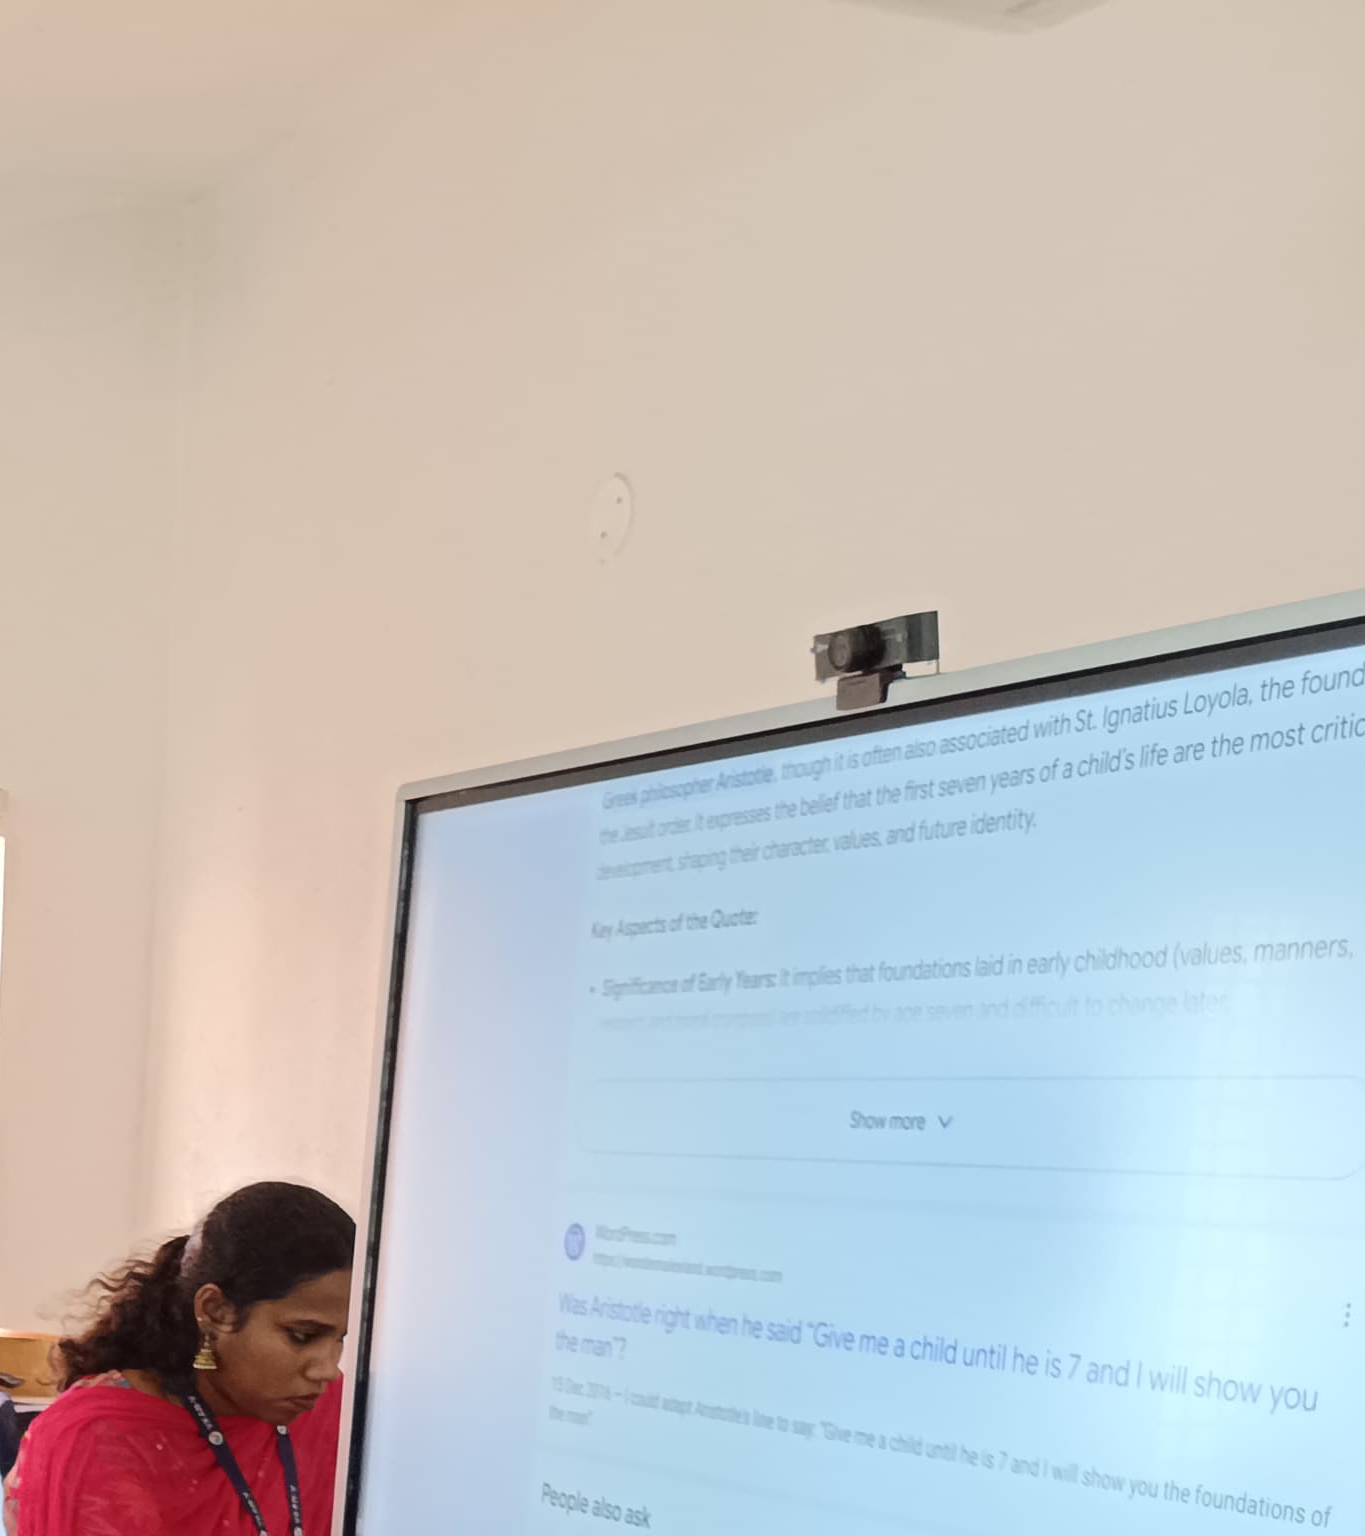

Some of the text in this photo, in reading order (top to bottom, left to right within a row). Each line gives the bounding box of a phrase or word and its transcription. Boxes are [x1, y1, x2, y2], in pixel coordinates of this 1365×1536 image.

[781, 757, 831, 781] though
[834, 752, 846, 771] it
[846, 750, 859, 769] is
[862, 745, 902, 767] often
[904, 740, 936, 760] also
[940, 720, 1029, 754] associated
[1033, 713, 1071, 739] with
[1075, 709, 1097, 733] St.
[1103, 697, 1178, 734] Ignatius
[1183, 683, 1253, 717] Loyola,
[1261, 677, 1295, 702] the
[706, 807, 771, 831] expresses
[775, 800, 797, 820] the
[800, 791, 841, 816] belief
[843, 789, 872, 810] that
[876, 784, 901, 806] the
[904, 779, 935, 800] first
[938, 775, 986, 797] seven
[991, 768, 1035, 794] years
[1039, 757, 1060, 783] of
[1062, 762, 1073, 779] a
[1140, 742, 1169, 768] life
[1173, 742, 1205, 764] are
[1211, 733, 1244, 758] the
[1250, 723, 1305, 752] most
[730, 842, 760, 864] their
[833, 830, 882, 850] values,
[886, 821, 916, 845] and
[918, 819, 967, 840] future
[970, 808, 1036, 835] identity.
[591, 922, 613, 938] Key
[616, 918, 667, 938] Aspects
[669, 913, 683, 932] of
[686, 913, 709, 930] the
[680, 974, 697, 992] of
[698, 972, 733, 993] Early
[780, 968, 791, 987] It
[793, 966, 842, 988] implies
[846, 964, 875, 984] that
[878, 958, 971, 982] foundations
[975, 954, 1004, 977] laid
[1008, 953, 1023, 974] in
[1027, 952, 1070, 978] early
[1074, 944, 1168, 973] childhood
[1173, 942, 1247, 970] (values,
[1254, 938, 1353, 961] manners,
[850, 1110, 926, 1131] Show more
[556, 1330, 578, 1352] the
[559, 1293, 590, 1316] Was
[589, 1296, 652, 1325] Aristotle
[655, 1304, 691, 1334] right
[695, 1310, 738, 1335] when
[742, 1314, 763, 1339] he
[767, 1320, 802, 1344] said
[859, 1334, 889, 1358] me
[893, 1338, 905, 1357] a
[910, 1336, 957, 1364] child
[963, 1344, 1007, 1370] until
[1013, 1346, 1039, 1375] he
[1045, 1349, 1061, 1378] is
[1069, 1353, 1082, 1379] 7
[1086, 1360, 1130, 1387] and
[1149, 1365, 1187, 1395] will
[1194, 1371, 1262, 1404] show
[1270, 1385, 1318, 1414] you
[542, 1482, 650, 1528] People also ask
[854, 1431, 876, 1448] me
[878, 1435, 886, 1450] a
[889, 1434, 923, 1456] child
[925, 1443, 960, 1462] until
[960, 1445, 979, 1466] he
[981, 1454, 994, 1469] is
[999, 1450, 1008, 1470] 7
[1011, 1457, 1039, 1477] and
[1052, 1464, 1079, 1483] will
[1081, 1467, 1125, 1492] show
[1130, 1480, 1158, 1498] you
[1164, 1480, 1190, 1504] the
[1196, 1484, 1305, 1524] foundations
[1311, 1506, 1332, 1528] of
